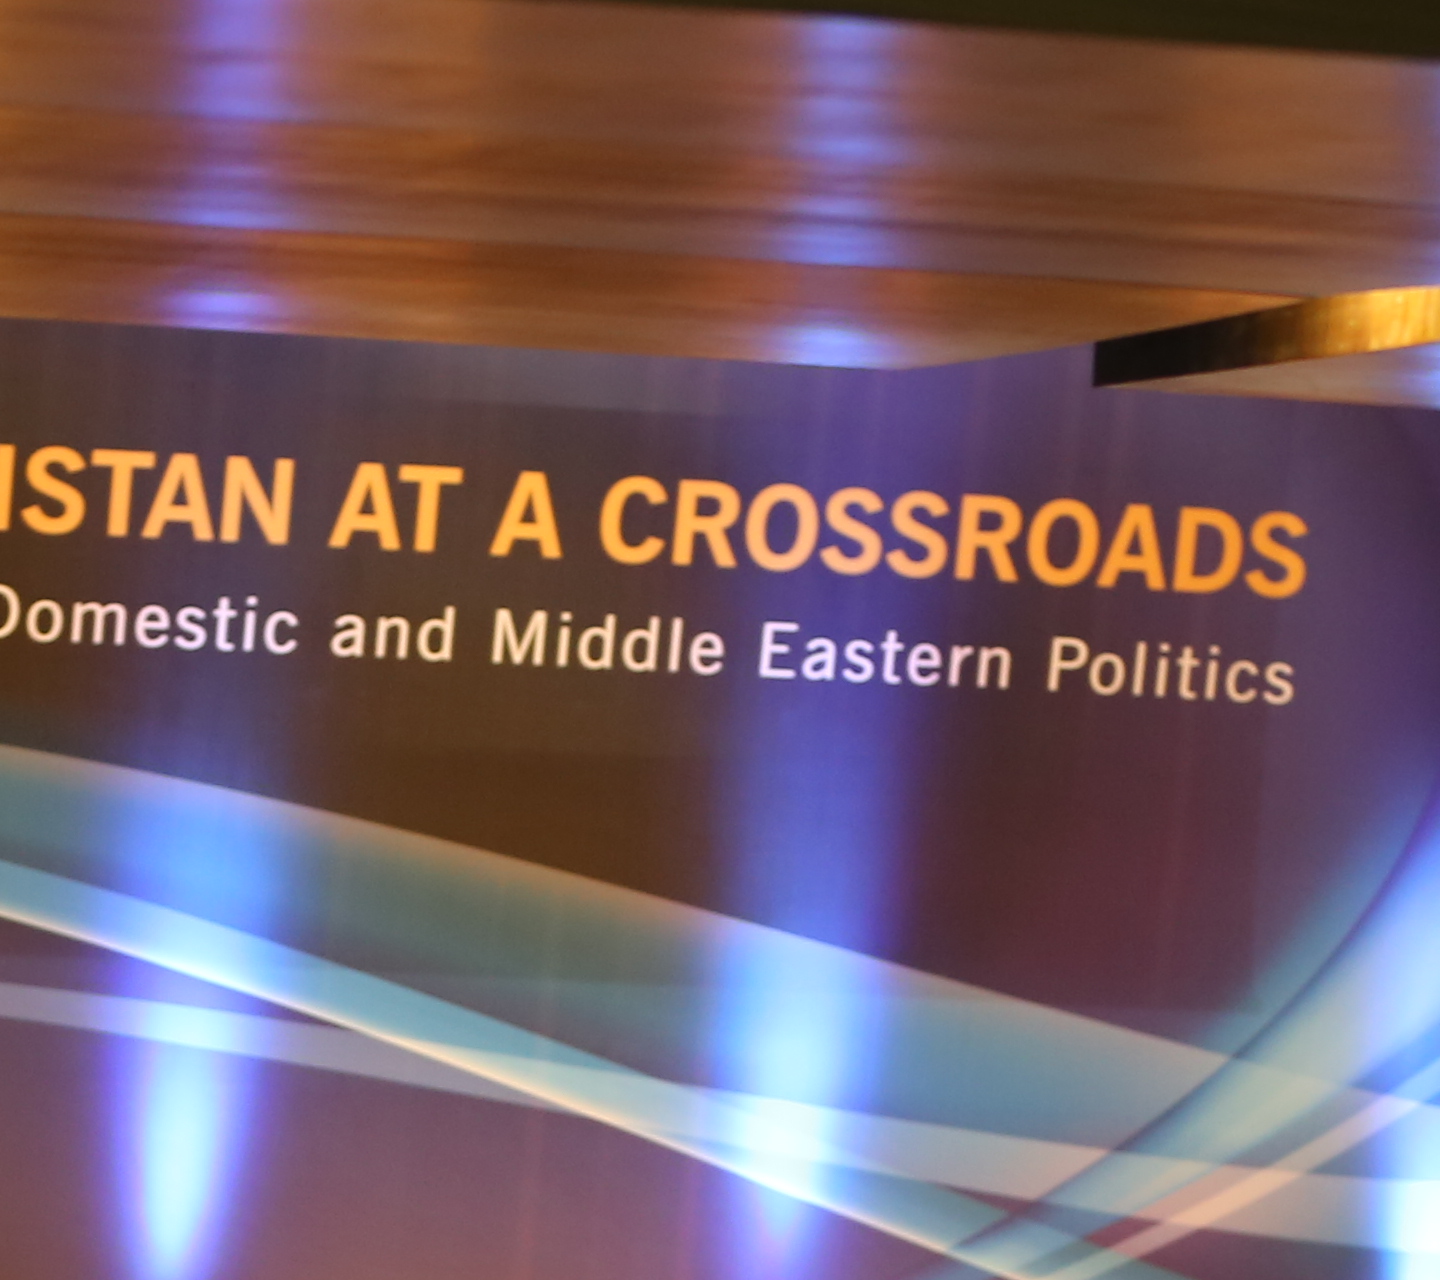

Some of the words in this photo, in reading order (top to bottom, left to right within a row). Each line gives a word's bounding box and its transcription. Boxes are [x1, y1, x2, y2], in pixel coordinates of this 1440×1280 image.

[327, 461, 464, 553] AT
[488, 469, 563, 560] A
[599, 475, 1309, 599] CROSSROADS
[329, 606, 457, 662] and
[490, 609, 725, 676] Middle
[758, 621, 1012, 690] Eastern
[1047, 637, 1296, 706] Politics
